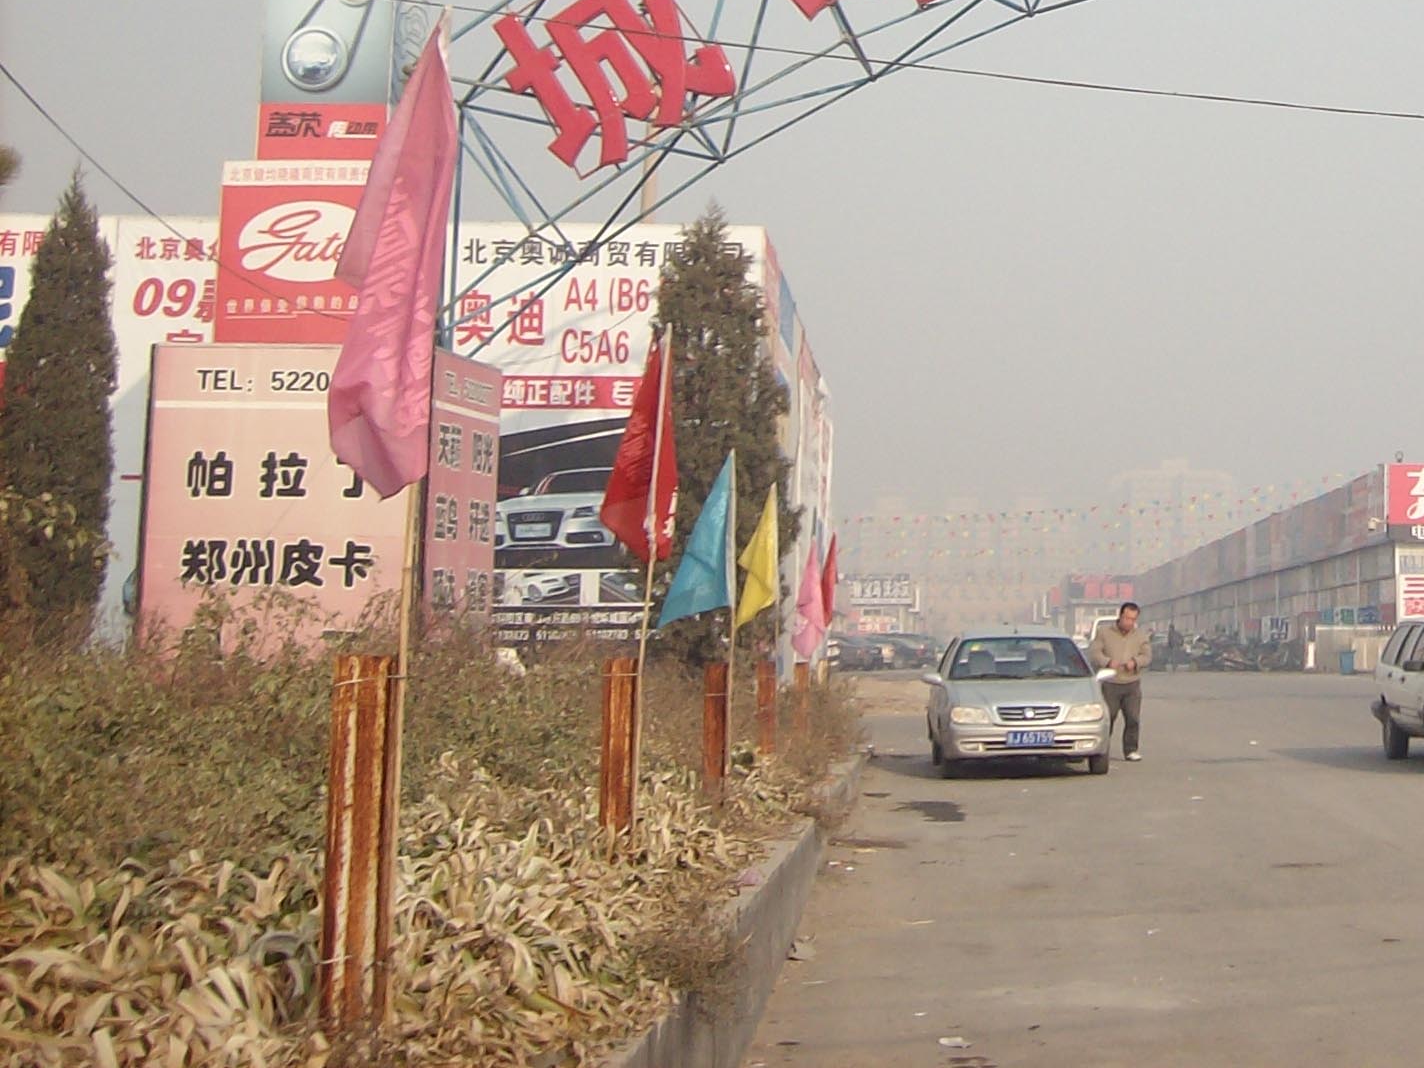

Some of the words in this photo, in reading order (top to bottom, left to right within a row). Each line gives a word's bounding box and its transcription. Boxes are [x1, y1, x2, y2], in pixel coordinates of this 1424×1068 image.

[463, 237, 746, 269] 北京奥诚商贸有限司
[455, 289, 546, 348] 奥迪
[564, 277, 598, 313] A4
[560, 328, 630, 365] C5A6
[502, 380, 596, 408] 纯正配件
[181, 539, 374, 588] 郑州皮卡
